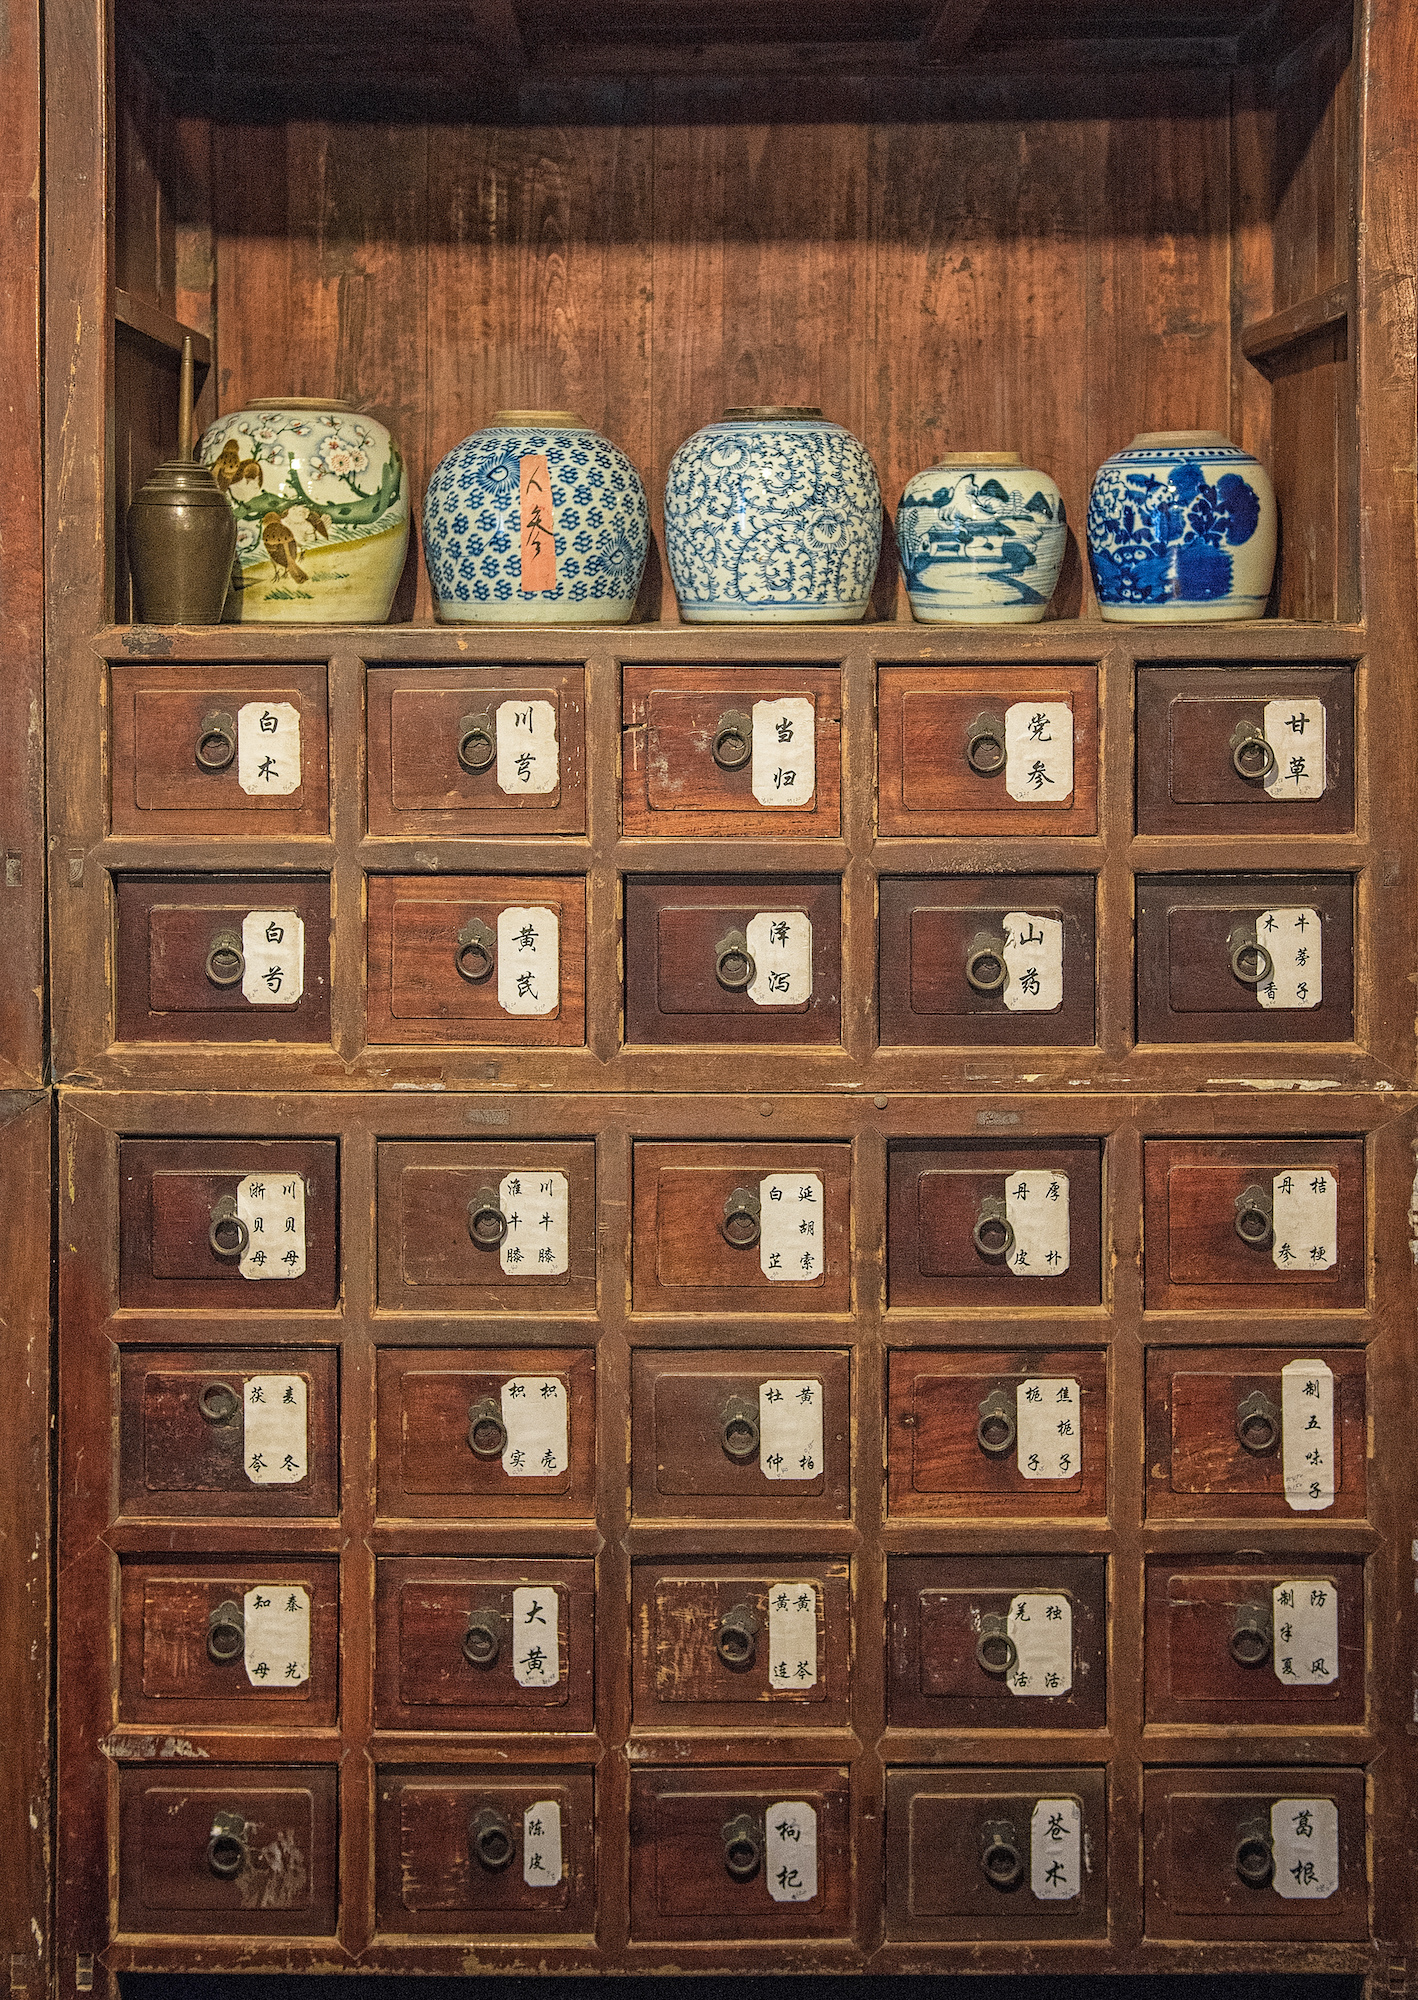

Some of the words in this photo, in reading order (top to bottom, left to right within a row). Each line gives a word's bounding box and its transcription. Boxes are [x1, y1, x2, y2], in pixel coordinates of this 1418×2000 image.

[257, 710, 279, 783] 白术
[514, 706, 536, 783] 川芎
[773, 717, 797, 790] 当归
[1026, 712, 1055, 791] 党参
[1284, 712, 1310, 786] 甘草
[261, 921, 285, 994] 白芍
[767, 920, 791, 993] 泽泻
[1019, 922, 1044, 996] 山药
[1263, 914, 1279, 1001] 木香
[1294, 913, 1310, 1000] 牛蒡子
[249, 1181, 267, 1267] 浙贝母
[281, 1180, 299, 1267] 川贝母
[538, 1178, 556, 1263] 川牛膝
[768, 1186, 783, 1270] 白芷
[798, 1185, 817, 1270] 延胡索
[1012, 1182, 1031, 1267] 丹皮
[1277, 1176, 1297, 1263] 丹参
[1309, 1176, 1328, 1262] 桔梗
[248, 1386, 268, 1473] 茯苓
[279, 1385, 300, 1472] 麦冬
[764, 1387, 784, 1472] 杜仲
[1025, 1386, 1043, 1471] 栀子
[1302, 1379, 1324, 1499] 制五味子
[252, 1594, 271, 1679] 知母
[519, 1600, 548, 1675] 大黄
[771, 1592, 791, 1679] 黄连
[792, 1593, 813, 1680] 黄芩
[1013, 1602, 1031, 1688] 羌活
[1044, 1606, 1062, 1688] 独活
[1310, 1590, 1330, 1675] 防风
[528, 1818, 546, 1871] 陈皮
[1043, 1812, 1071, 1888] 苍术
[1289, 1809, 1319, 1886] 葛根
